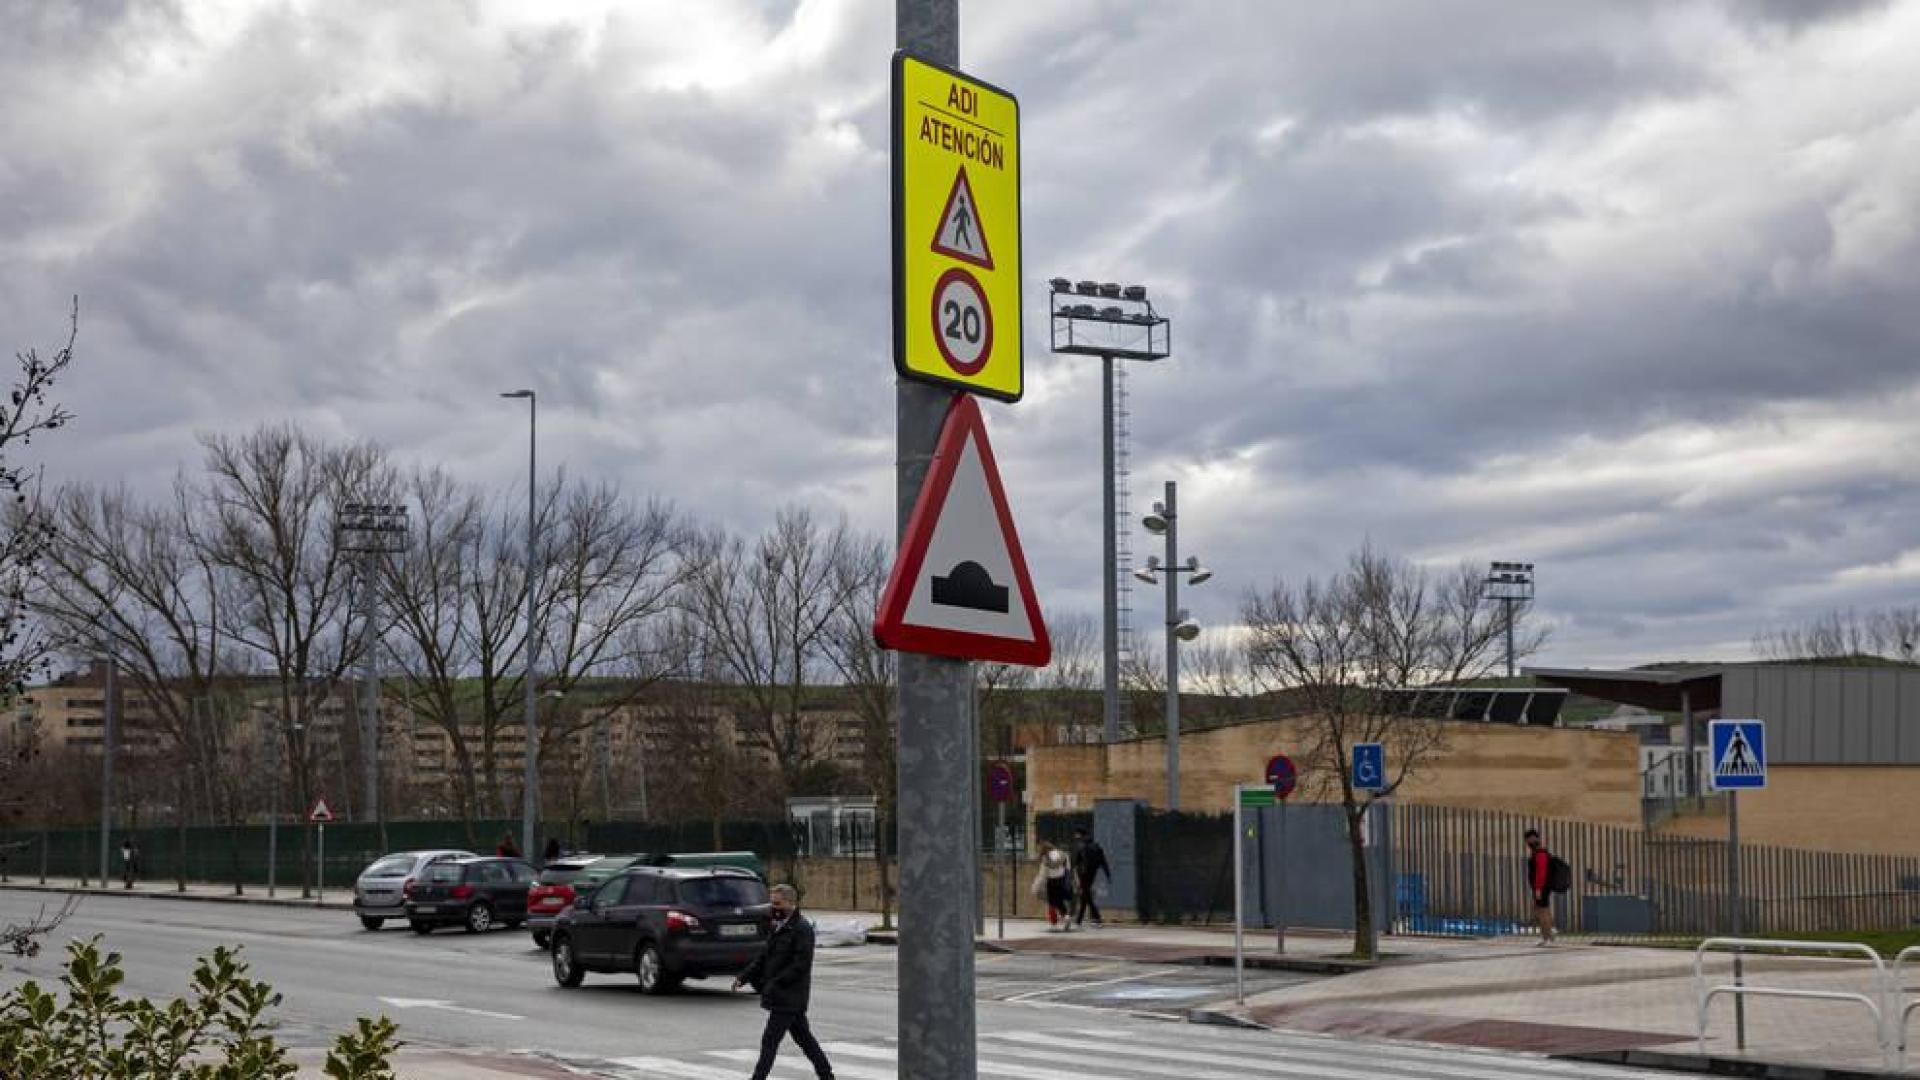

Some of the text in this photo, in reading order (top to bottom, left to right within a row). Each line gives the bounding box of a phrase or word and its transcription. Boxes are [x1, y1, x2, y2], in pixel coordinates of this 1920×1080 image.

[947, 82, 978, 118] ADI
[920, 115, 1004, 171] ATENCIÓN
[944, 300, 980, 344] 20
